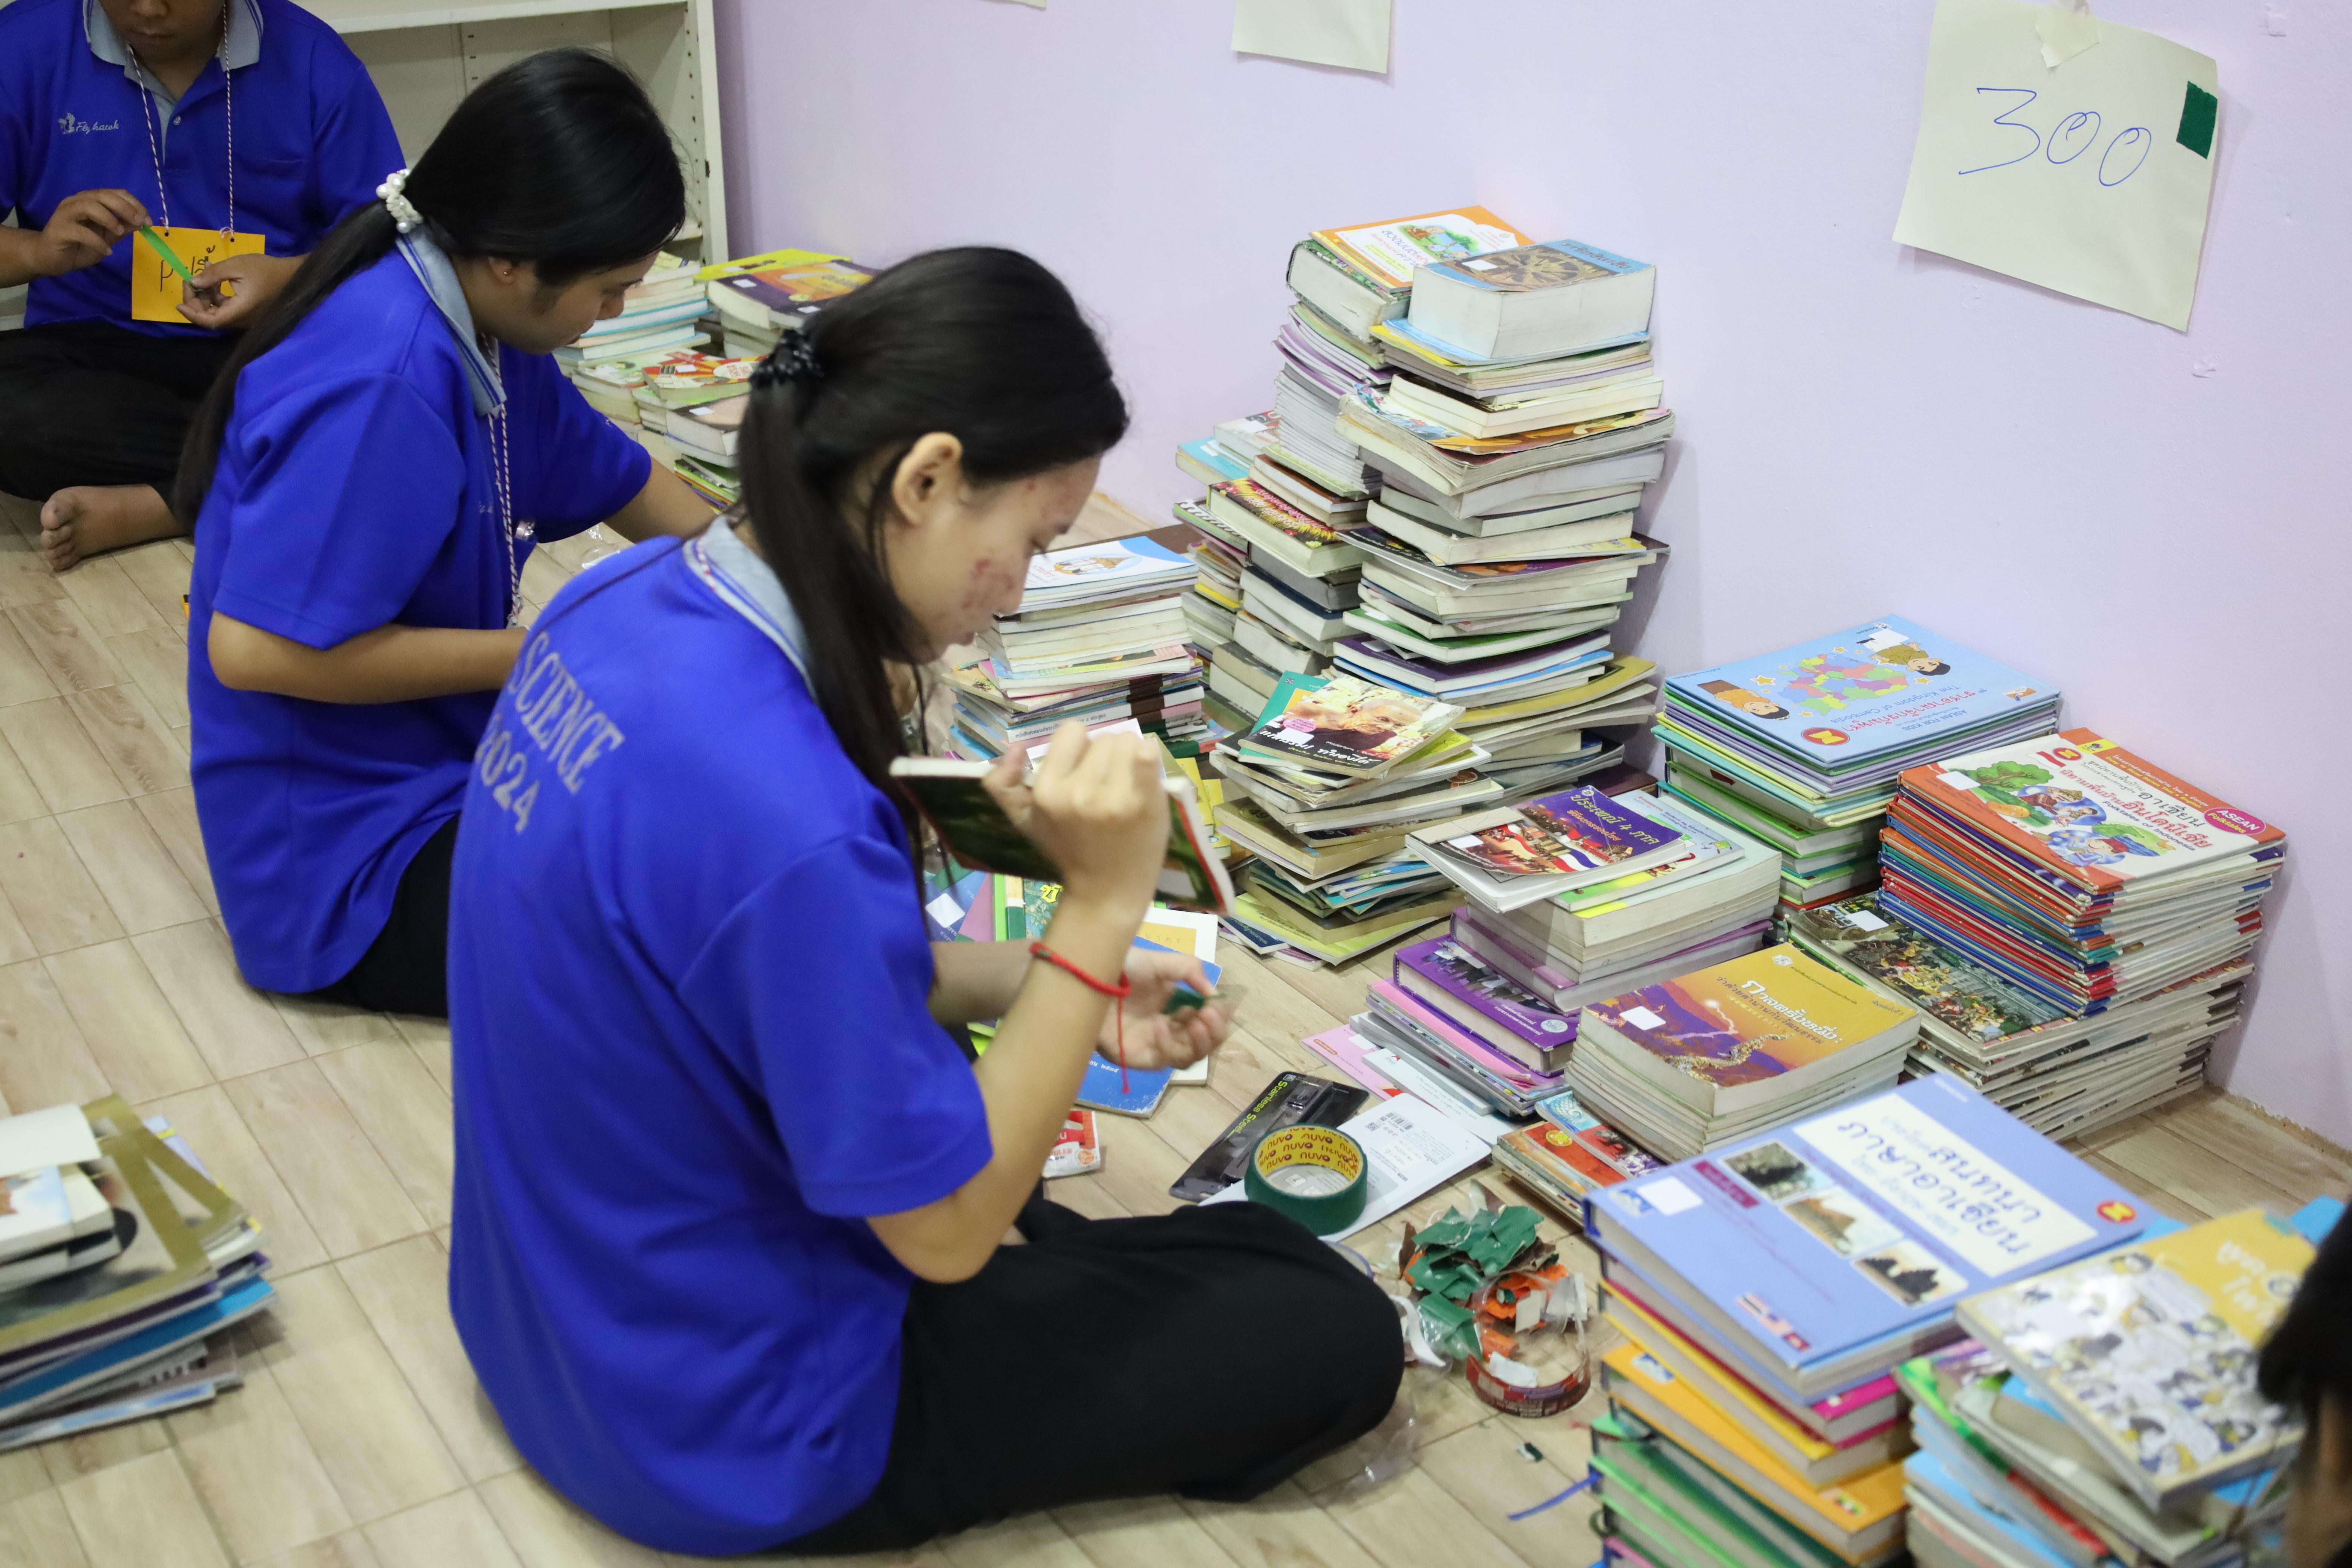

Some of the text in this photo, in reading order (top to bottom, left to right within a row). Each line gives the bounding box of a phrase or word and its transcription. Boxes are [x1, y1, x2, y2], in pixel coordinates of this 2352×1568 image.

[1959, 88, 2151, 186] 300
[1894, 691, 1939, 706] Kingdom
[507, 631, 625, 795] SCIENCE
[1831, 709, 1880, 723] Cambodia
[1842, 691, 1975, 731] ราชอาณาจักรกัมพูชา
[1942, 710, 1967, 720] ASEAN
[1571, 793, 1627, 824] ประเพณี
[1629, 830, 1660, 845] ภาค
[2100, 801, 2142, 822] Folktales
[2152, 828, 2196, 851] Indonesia
[2207, 813, 2248, 833] Folktales
[2220, 811, 2260, 830] ASEAN
[1234, 1081, 1288, 1133] Stainless Steel
[1268, 1134, 1292, 1150] nuvo
[1283, 1142, 1313, 1152] nuvo
[1266, 1154, 1292, 1170] nuvo
[1300, 1152, 1330, 1162] nuvo
[1838, 1120, 2031, 1254] ภาษาอาเซียน
